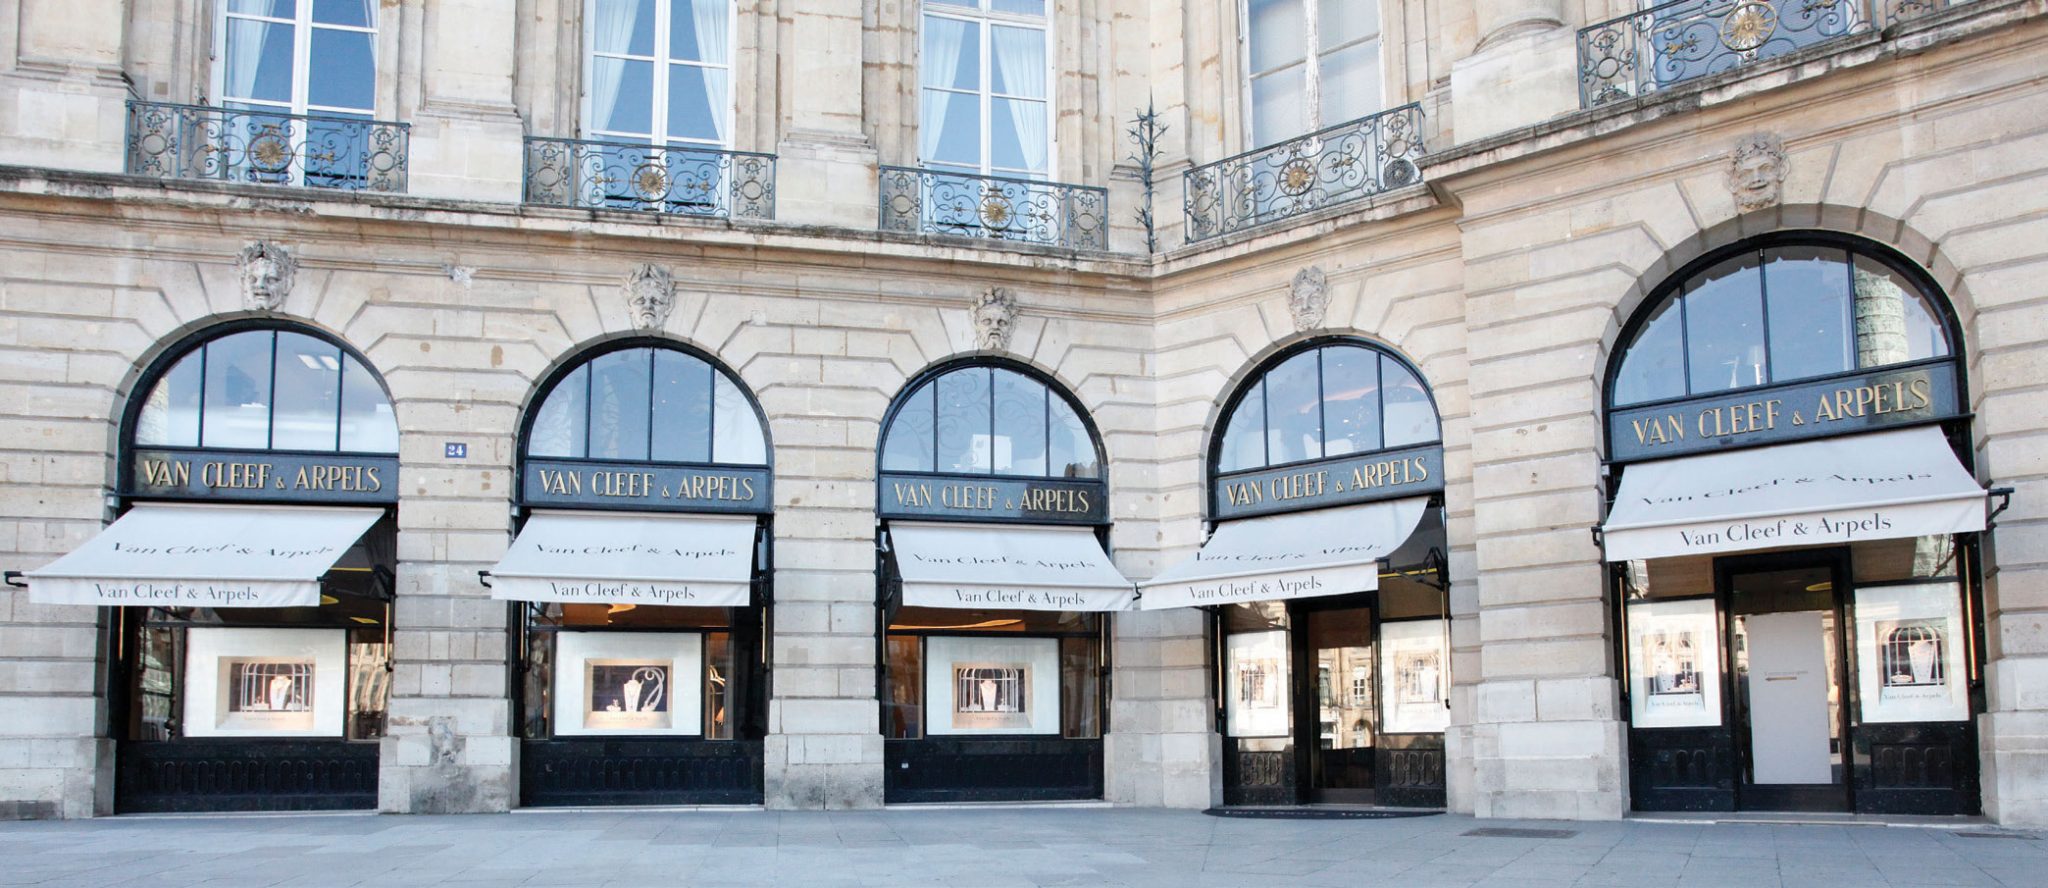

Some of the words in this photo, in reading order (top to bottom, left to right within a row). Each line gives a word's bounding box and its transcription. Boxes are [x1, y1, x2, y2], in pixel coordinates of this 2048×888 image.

[1631, 413, 1685, 446] VAN
[1698, 399, 1782, 439] CLEEF
[1793, 411, 1804, 426] &
[1814, 379, 1931, 423] ARPELS
[448, 445, 463, 456] 24
[143, 459, 191, 486] VAN
[202, 462, 272, 489] CLEEF
[275, 477, 287, 489] &
[294, 465, 382, 493] ARPELS
[539, 470, 582, 496] VAN
[592, 471, 655, 497] CLEEF
[662, 485, 671, 498] &
[676, 476, 754, 501] ARPELS
[1227, 480, 1264, 507] VAN
[1271, 470, 1329, 501] CLEEF
[1336, 480, 1344, 493] &
[1350, 456, 1428, 491] ARPELS
[894, 482, 932, 507] VAN
[942, 486, 999, 510] CLEEF
[1005, 497, 1013, 510] &
[1019, 489, 1089, 513] ARPELS
[1642, 495, 1693, 506] Van
[1704, 478, 1785, 499] Cleef
[1680, 529, 1720, 547] Van
[1726, 520, 1786, 543] Cleef
[1793, 522, 1809, 537] &
[1816, 513, 1892, 538] Arpels
[114, 542, 157, 554] Van
[166, 543, 236, 554] Cleef
[537, 544, 575, 554] Van
[583, 544, 641, 555] Cleef
[668, 548, 735, 559] Arpels
[913, 553, 950, 564] Van
[957, 556, 1009, 565] Cleef
[1035, 560, 1096, 571] Arpels
[96, 583, 127, 599] Van
[134, 584, 182, 599] Cleef
[187, 589, 199, 599] &
[206, 586, 259, 604] Arpels
[551, 582, 580, 596] Van
[585, 582, 628, 597] Cleef
[631, 587, 641, 597] &
[649, 585, 695, 603] Arpels
[955, 589, 982, 603] Van
[986, 590, 1025, 603] Cleef
[1028, 595, 1037, 603] &
[1041, 592, 1086, 608] Arpels
[1189, 586, 1214, 600] Van
[1219, 580, 1256, 598] Cleef
[1261, 584, 1271, 593] &
[1276, 576, 1322, 595] Arpels
